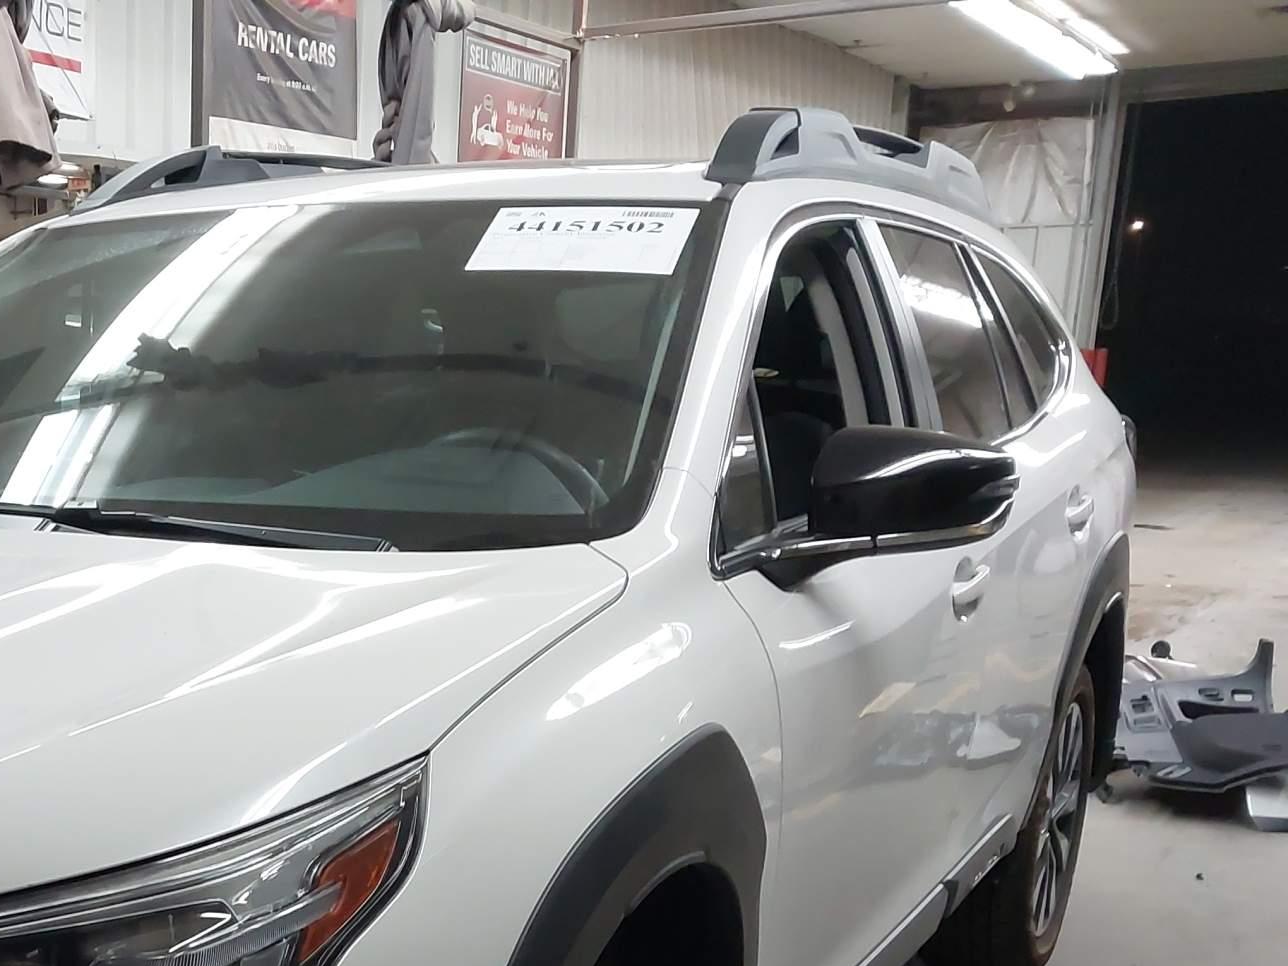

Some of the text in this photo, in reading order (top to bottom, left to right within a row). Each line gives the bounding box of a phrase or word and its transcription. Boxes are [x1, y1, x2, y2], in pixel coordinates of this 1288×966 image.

[237, 21, 336, 67] RENTAL CARS
[469, 44, 490, 70] SELL
[490, 51, 522, 78] SMART
[523, 61, 546, 86] WITH
[506, 100, 518, 116] We
[536, 107, 549, 123] You
[506, 119, 554, 142] Earn More For
[506, 139, 549, 160] Your Vehicle
[507, 220, 665, 234] 44151502
